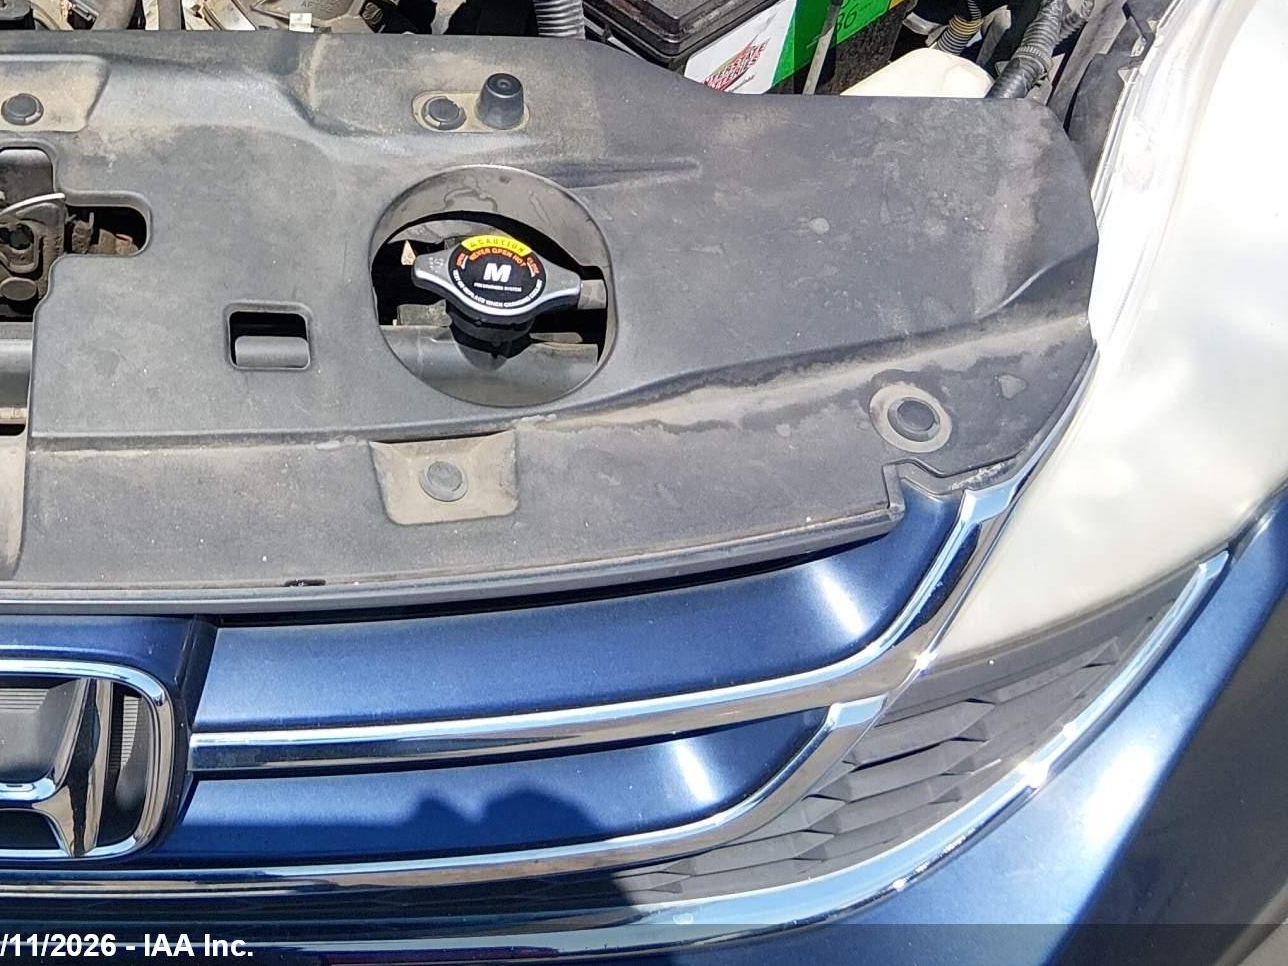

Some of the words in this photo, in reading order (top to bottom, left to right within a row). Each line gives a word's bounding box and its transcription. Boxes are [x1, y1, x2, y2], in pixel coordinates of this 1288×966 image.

[477, 238, 526, 253] CAUTION
[468, 248, 491, 261] NEVER
[491, 247, 513, 258] OPEN
[512, 254, 527, 267] HOT
[482, 262, 512, 283] M
